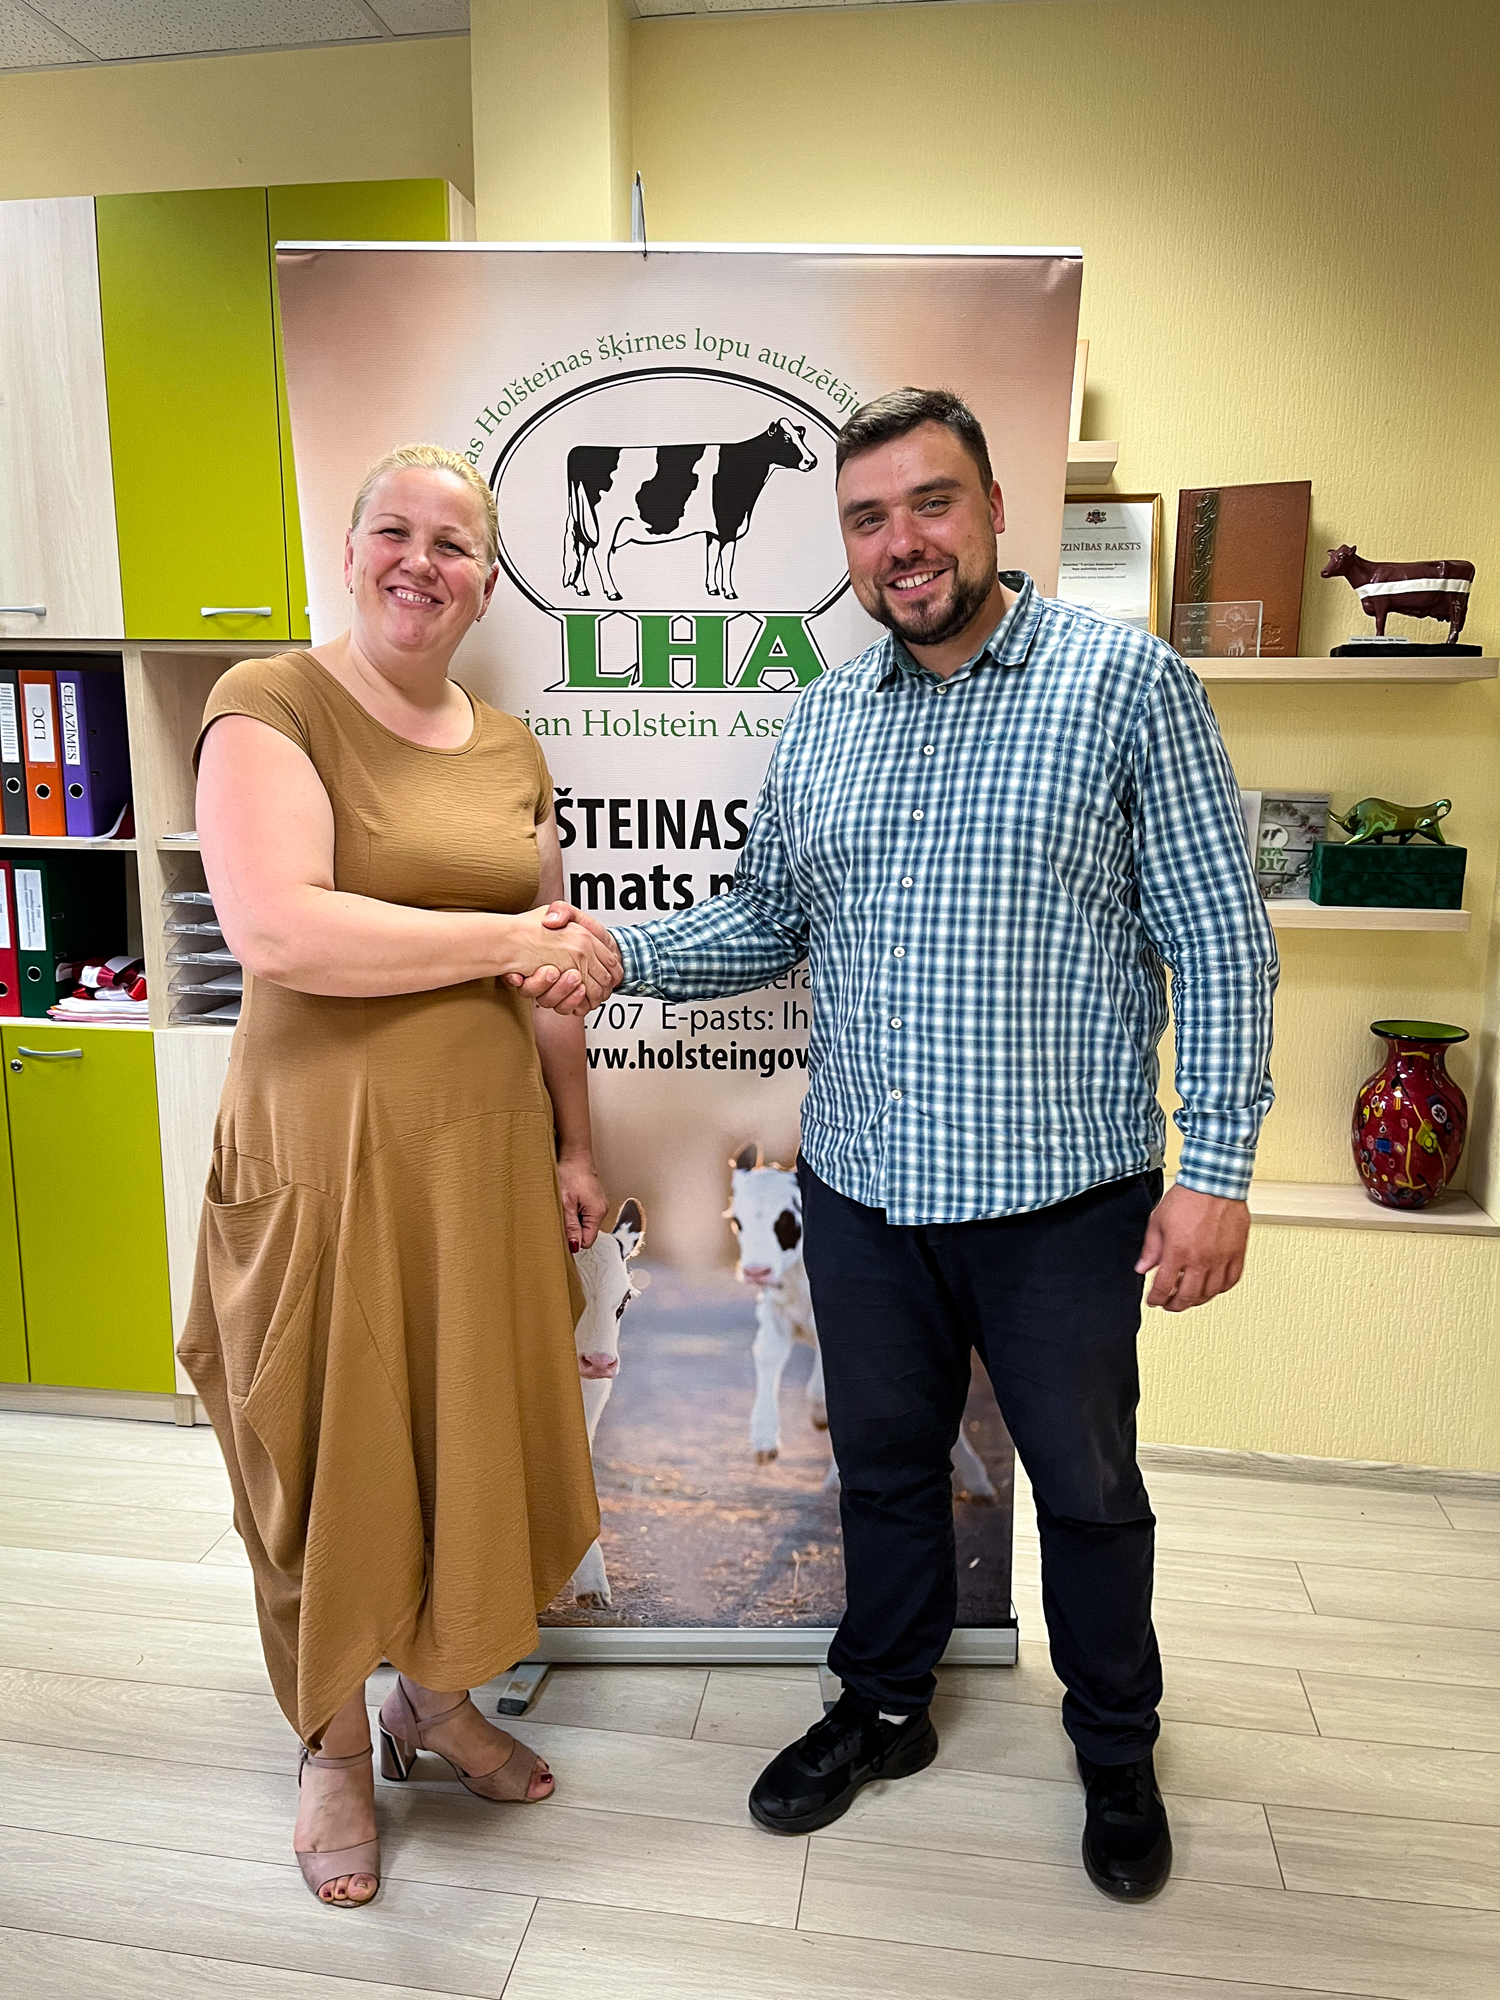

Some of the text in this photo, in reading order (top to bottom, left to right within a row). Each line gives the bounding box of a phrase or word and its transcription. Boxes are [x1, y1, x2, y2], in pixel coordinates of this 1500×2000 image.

[474, 349, 593, 437] Holšteinas
[596, 332, 687, 363] šķirnes
[694, 327, 750, 362] lopu
[1105, 541, 1142, 551] RAKSTS
[547, 611, 829, 691] LHA
[32, 707, 46, 741] LDC
[519, 708, 784, 738] ian Holstein Ass
[553, 787, 749, 850] ŠTEINAS
[569, 864, 695, 912] mats
[584, 1000, 812, 1037] 707 E-pasts: lh
